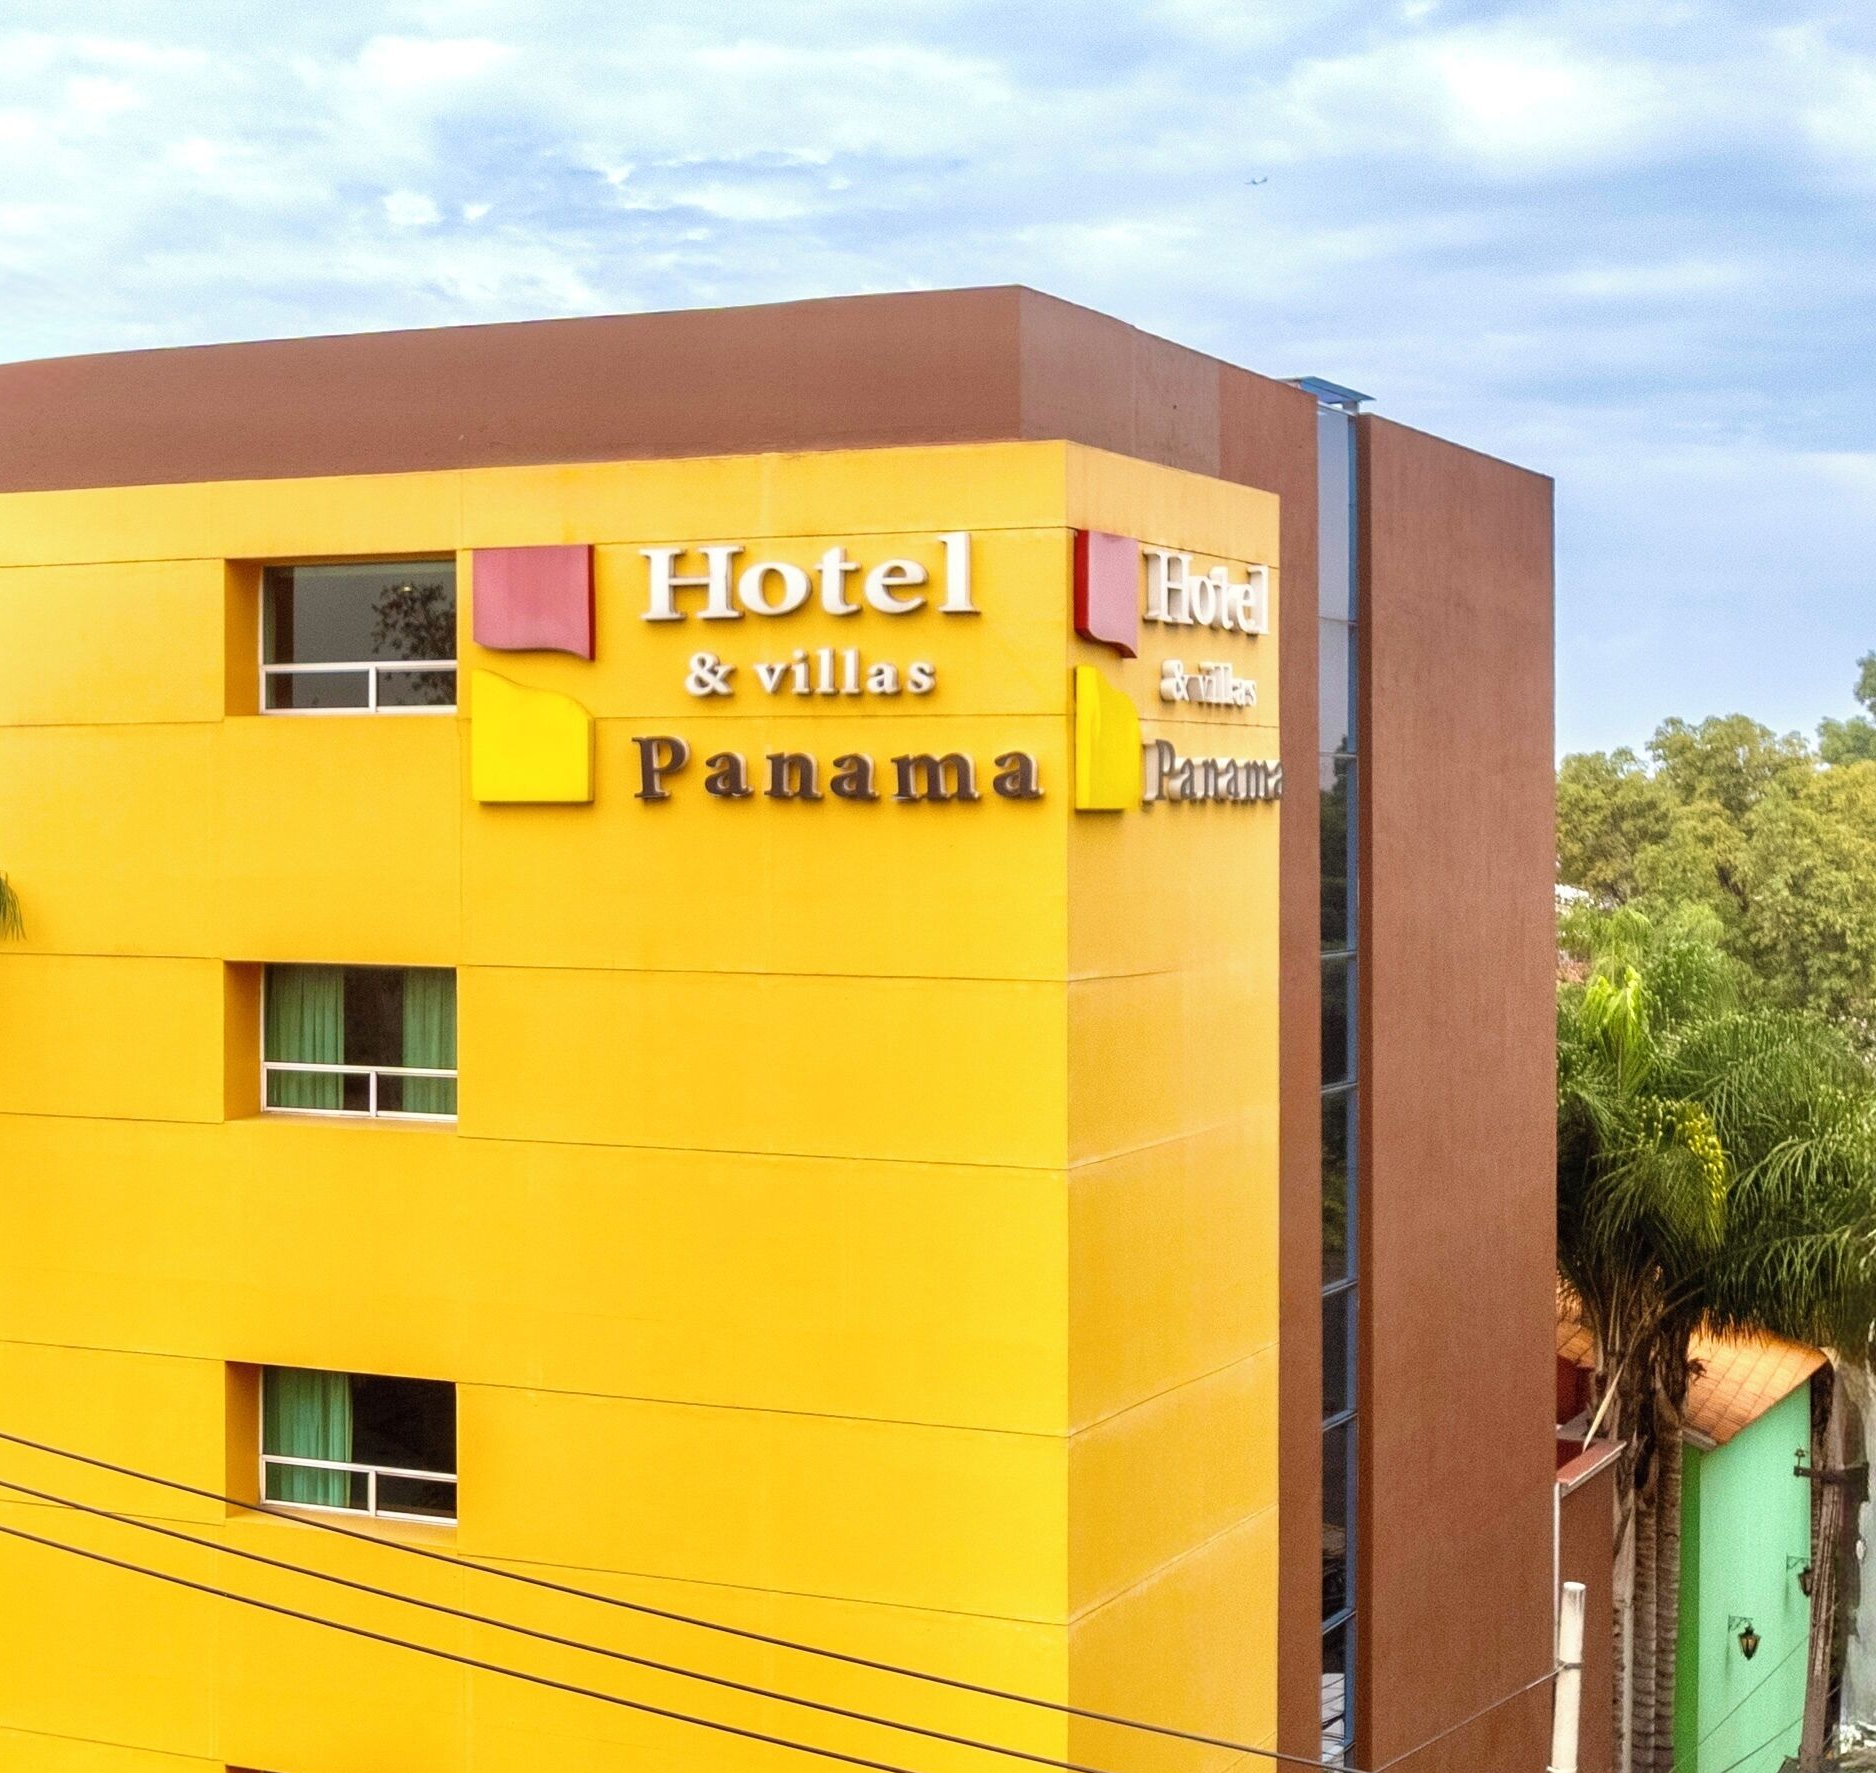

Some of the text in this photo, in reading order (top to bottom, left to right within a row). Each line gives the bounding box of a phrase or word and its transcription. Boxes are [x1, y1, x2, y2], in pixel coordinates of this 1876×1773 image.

[640, 531, 981, 622] Hotel
[1143, 549, 1270, 636] Hotel
[685, 646, 937, 697] & villas
[1160, 659, 1257, 707] & villas
[632, 732, 1047, 802] Panama
[1144, 738, 1283, 801] Panama
